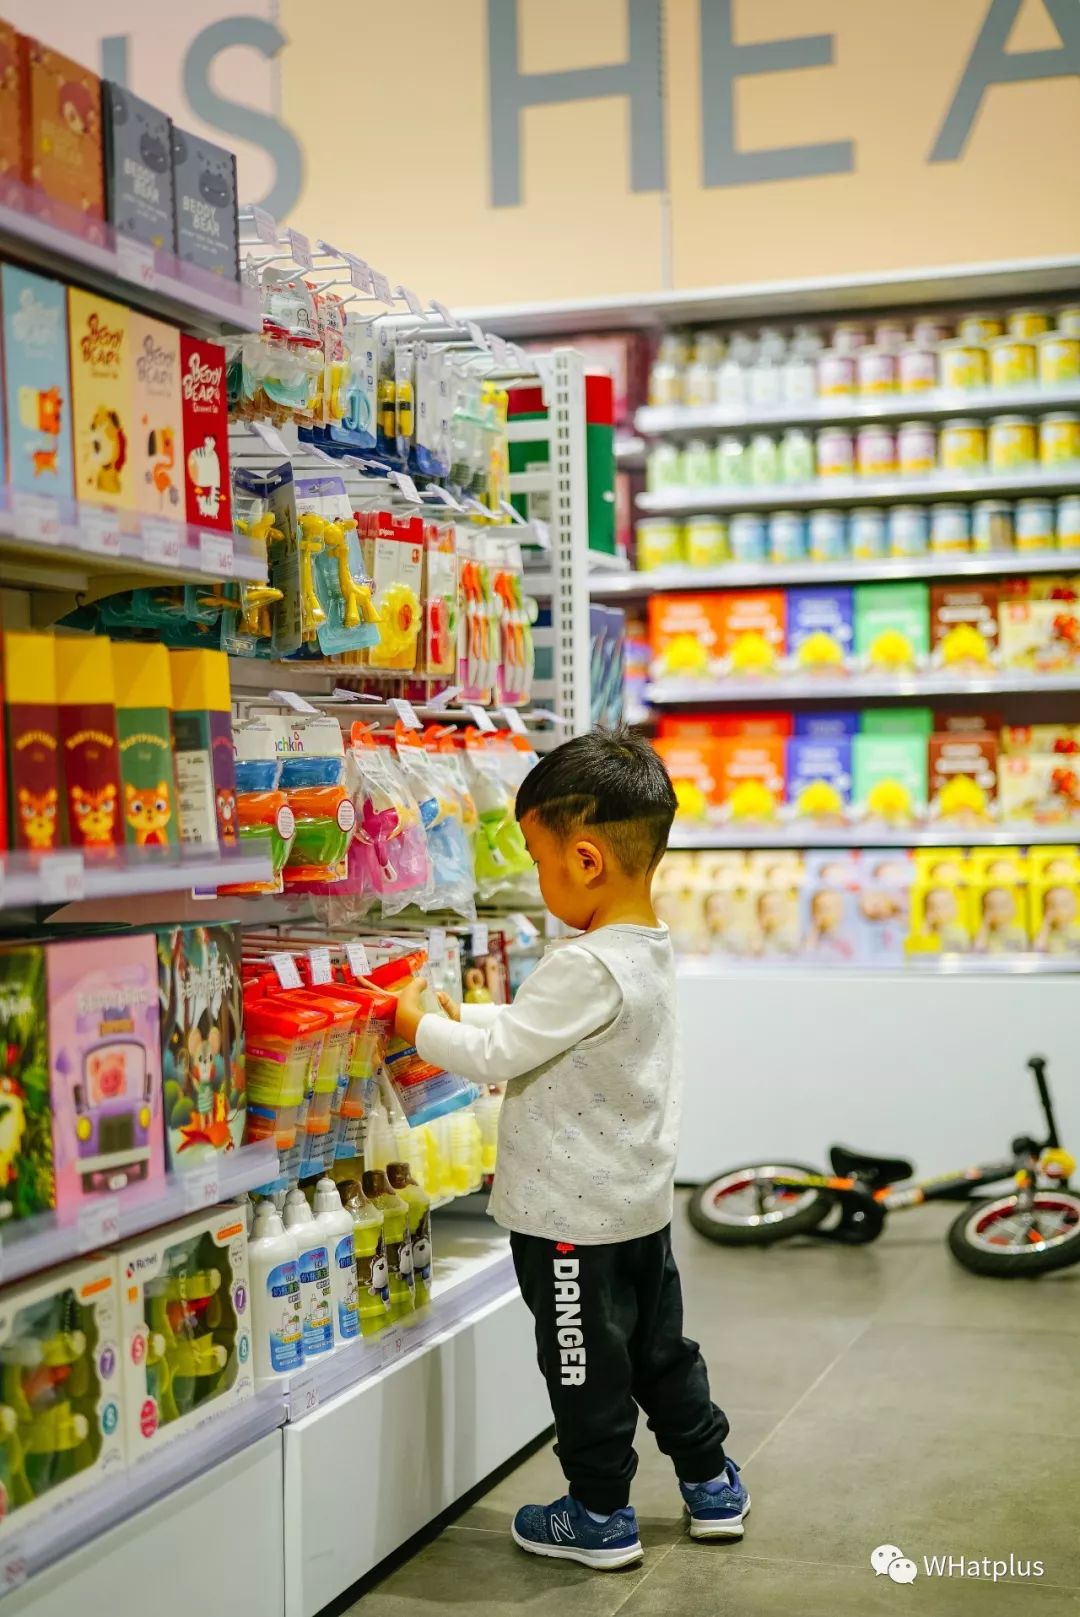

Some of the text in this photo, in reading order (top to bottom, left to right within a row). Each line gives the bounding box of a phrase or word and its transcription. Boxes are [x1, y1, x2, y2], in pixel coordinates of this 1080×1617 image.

[101, 15, 306, 229] S
[182, 196, 217, 220] BEDDY
[192, 211, 221, 237] BEAR
[188, 352, 222, 387] BEDDY
[553, 1258, 587, 1386] DANGER
